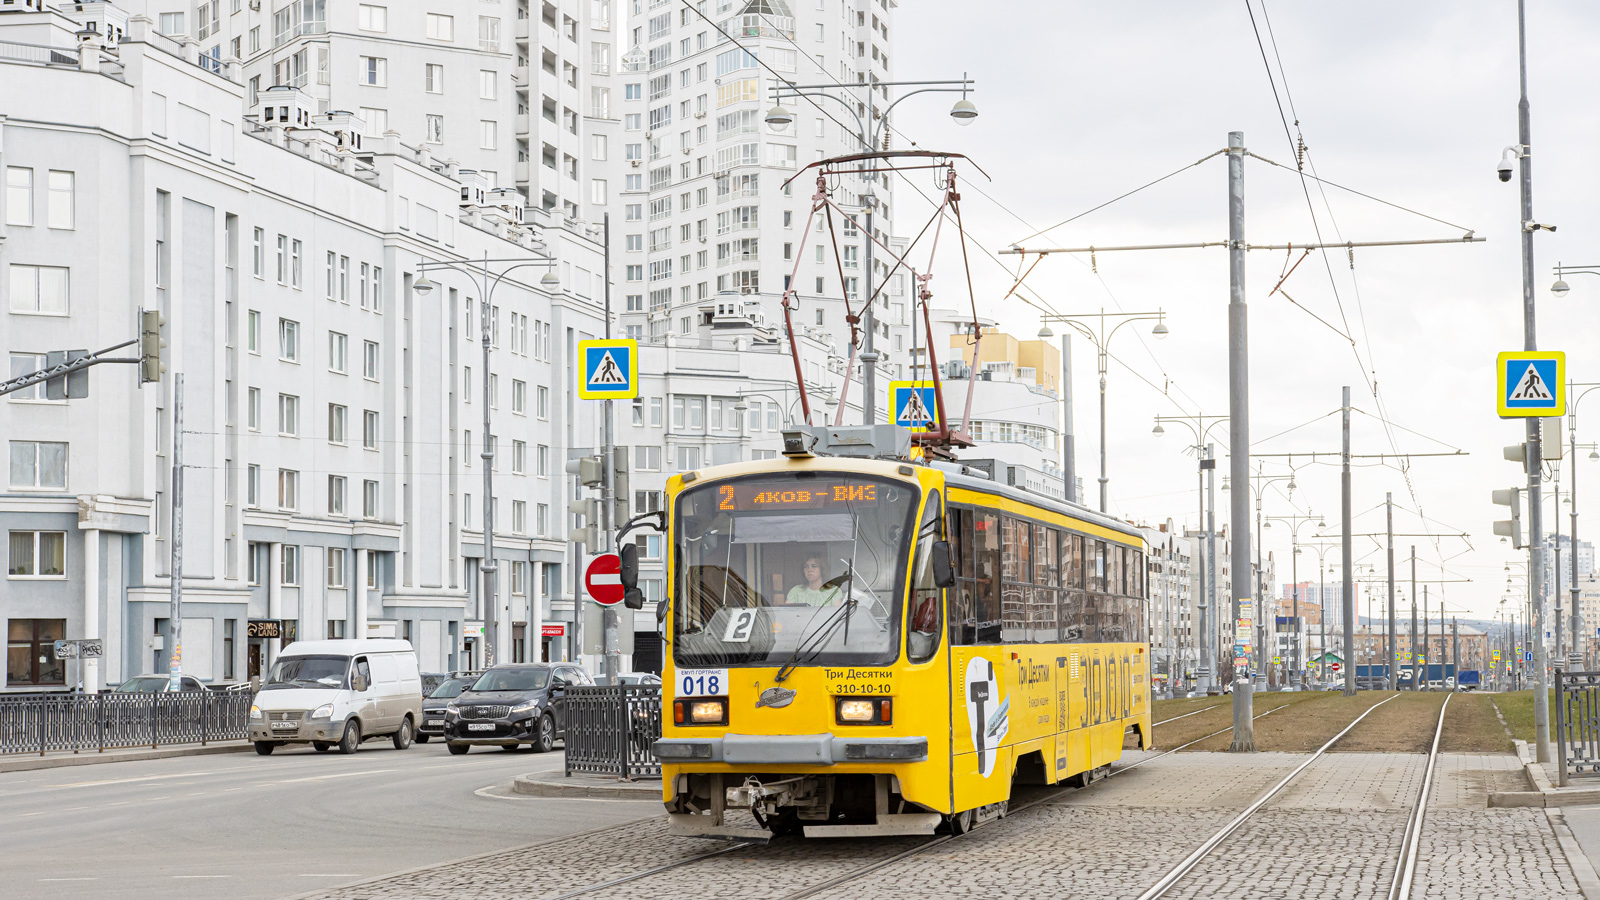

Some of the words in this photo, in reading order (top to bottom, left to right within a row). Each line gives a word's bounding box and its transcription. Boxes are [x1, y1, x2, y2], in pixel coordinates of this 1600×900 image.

[719, 485, 734, 510] 2
[733, 612, 752, 639] 2
[683, 675, 720, 696] 018
[824, 669, 844, 681] Три
[846, 669, 893, 681] Десятки
[836, 684, 891, 694] 310-10-10
